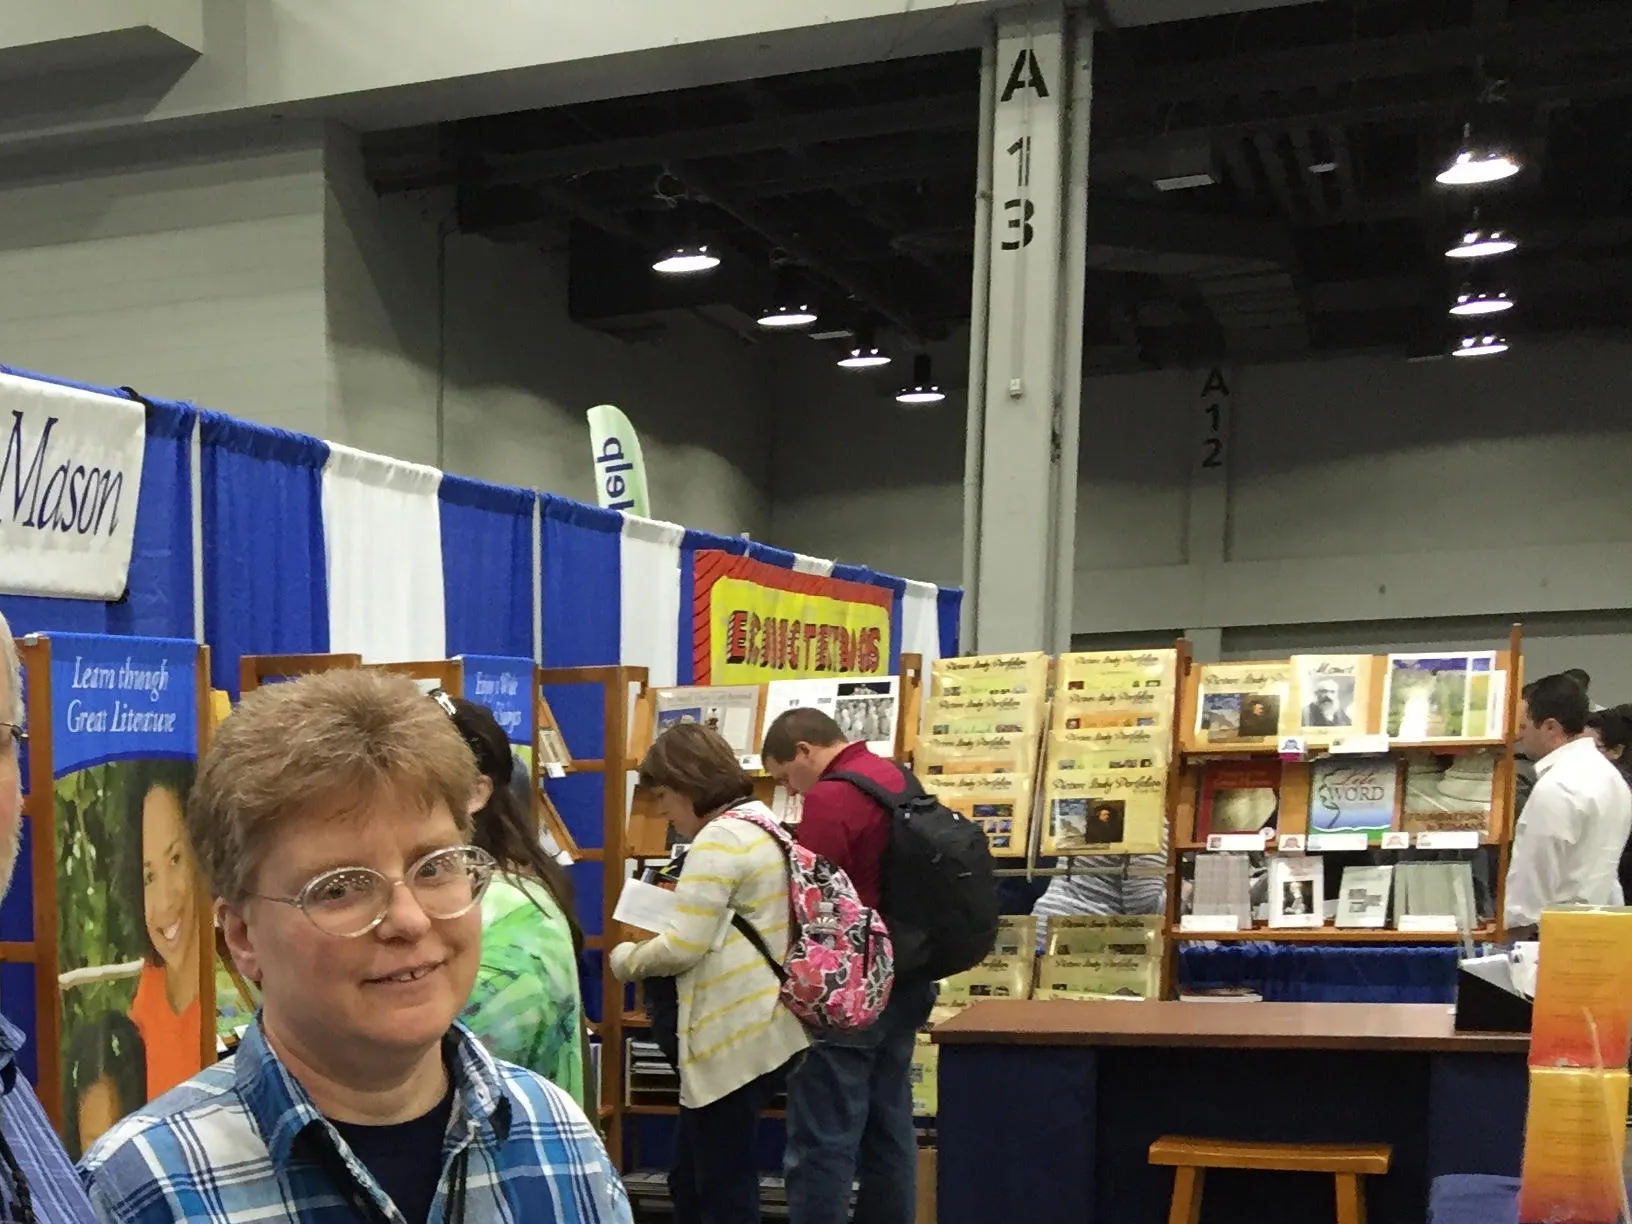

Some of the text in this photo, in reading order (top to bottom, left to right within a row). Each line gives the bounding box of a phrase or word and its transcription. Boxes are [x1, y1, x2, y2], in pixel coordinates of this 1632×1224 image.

[71, 655, 169, 702] Learn through
[67, 699, 176, 733] Great Literature
[1328, 785, 1385, 801] WORD
